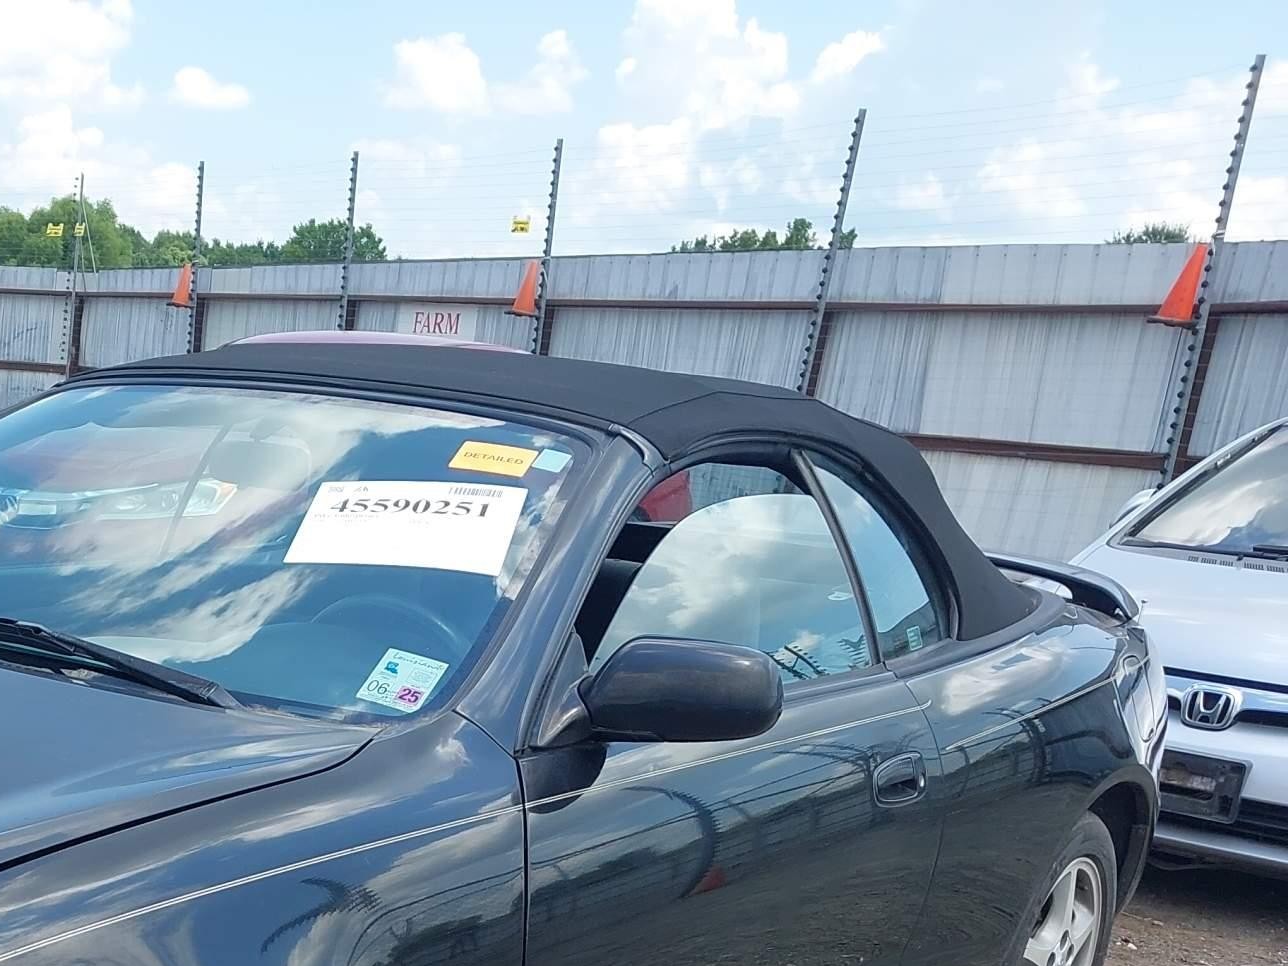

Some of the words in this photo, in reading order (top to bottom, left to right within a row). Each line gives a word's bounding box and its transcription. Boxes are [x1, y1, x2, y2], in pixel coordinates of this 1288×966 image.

[413, 311, 461, 334] FARM
[464, 451, 524, 465] DETAILED
[329, 498, 490, 517] 45590251
[367, 680, 390, 695] 06
[399, 688, 421, 703] 25
